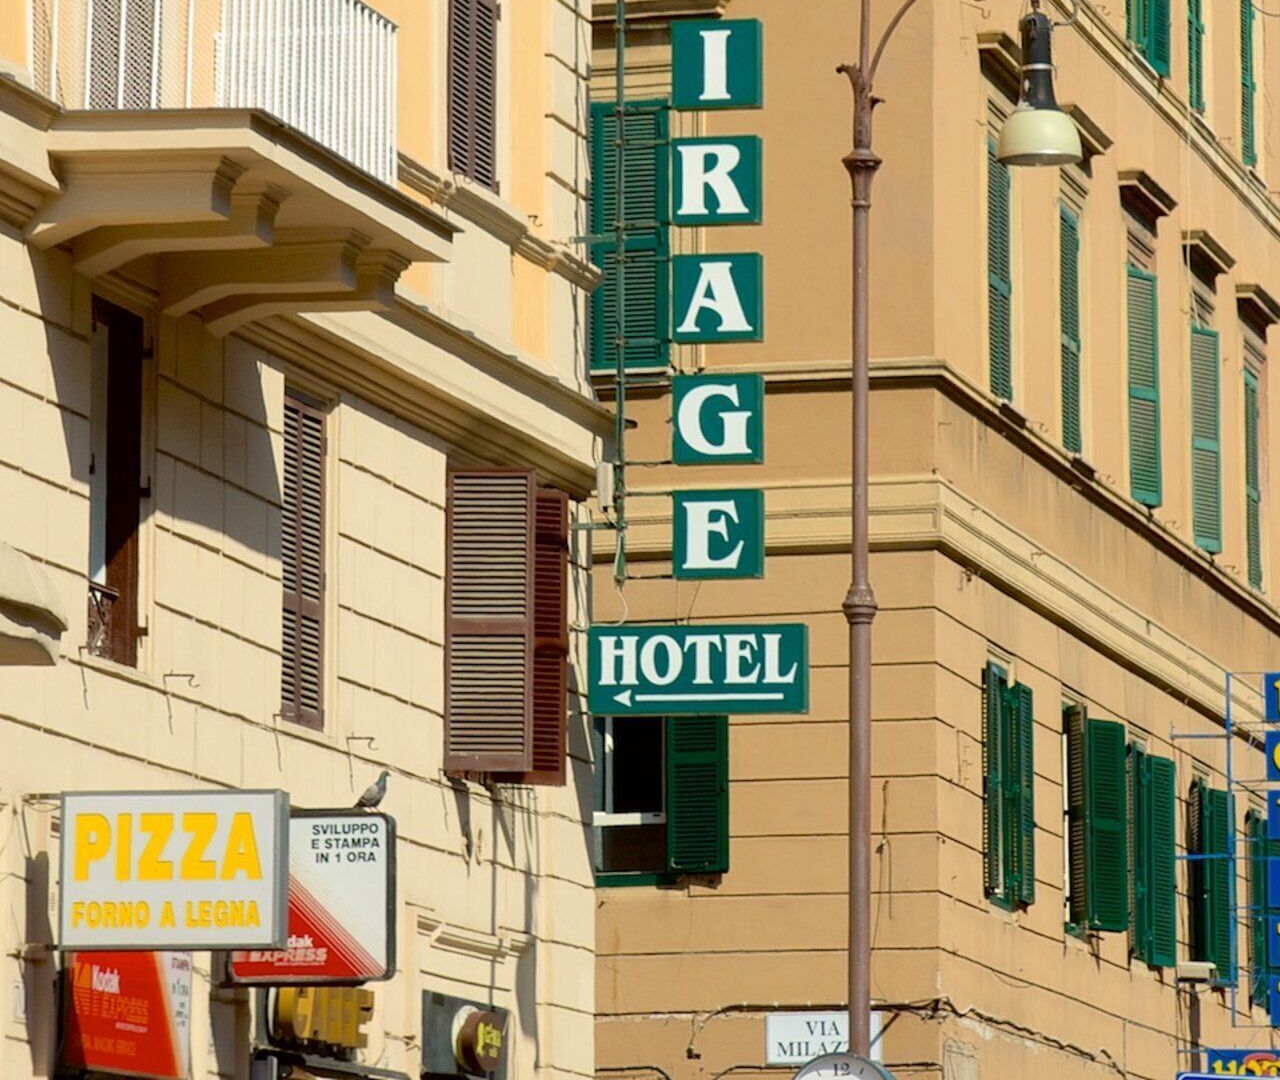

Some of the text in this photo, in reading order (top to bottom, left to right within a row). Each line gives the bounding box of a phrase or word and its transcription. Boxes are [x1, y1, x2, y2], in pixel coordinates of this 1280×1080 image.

[598, 633, 798, 688] HOTEL
[312, 823, 380, 837] SVILUPPO
[73, 811, 263, 882] PIZZA
[311, 837, 381, 850] E STAMPA
[316, 851, 377, 864] IN 1 ORA
[71, 900, 152, 929] FORNO
[158, 900, 176, 929] A
[184, 899, 261, 928] LEGNA
[287, 934, 314, 948] dak
[805, 1020, 841, 1037] VIA
[776, 1040, 848, 1058] MILAZ
[832, 1061, 851, 1077] 12
